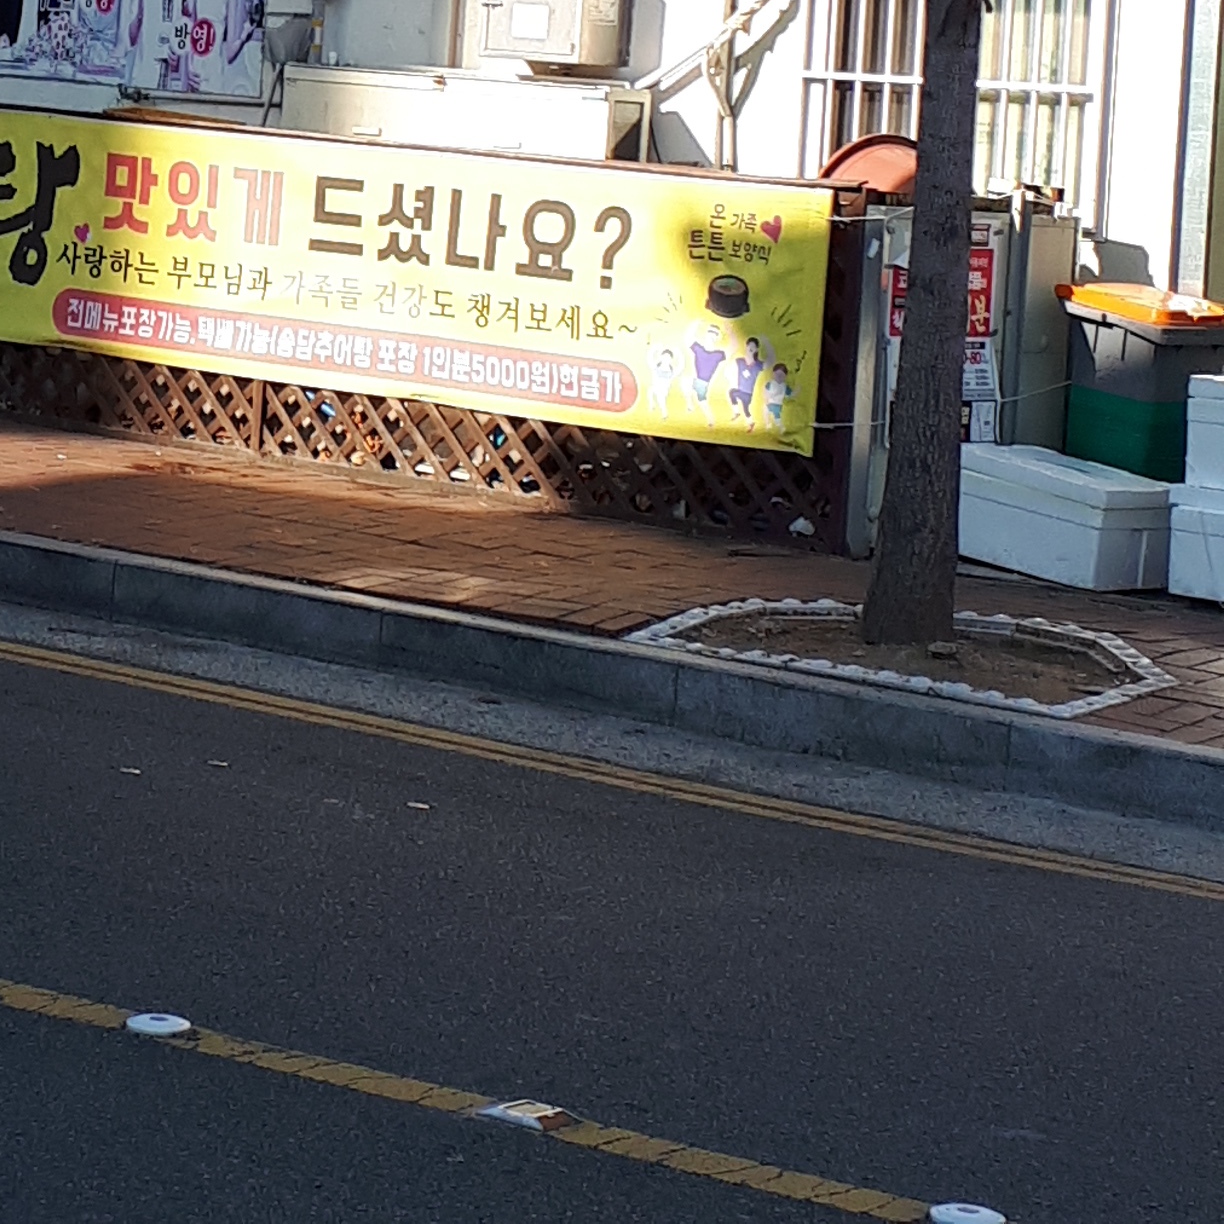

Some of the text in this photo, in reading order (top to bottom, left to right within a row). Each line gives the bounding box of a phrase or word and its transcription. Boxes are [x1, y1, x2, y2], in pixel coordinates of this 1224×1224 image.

[102, 150, 285, 247] 맛있게
[307, 174, 634, 290] 드셨나요?
[709, 203, 757, 234] 온 가족
[687, 229, 772, 266] 튼튼 보양식
[56, 240, 638, 341] 사랑하는 부모님과 가족들 건강도 챙겨보세요~
[375, 338, 419, 375] 포장
